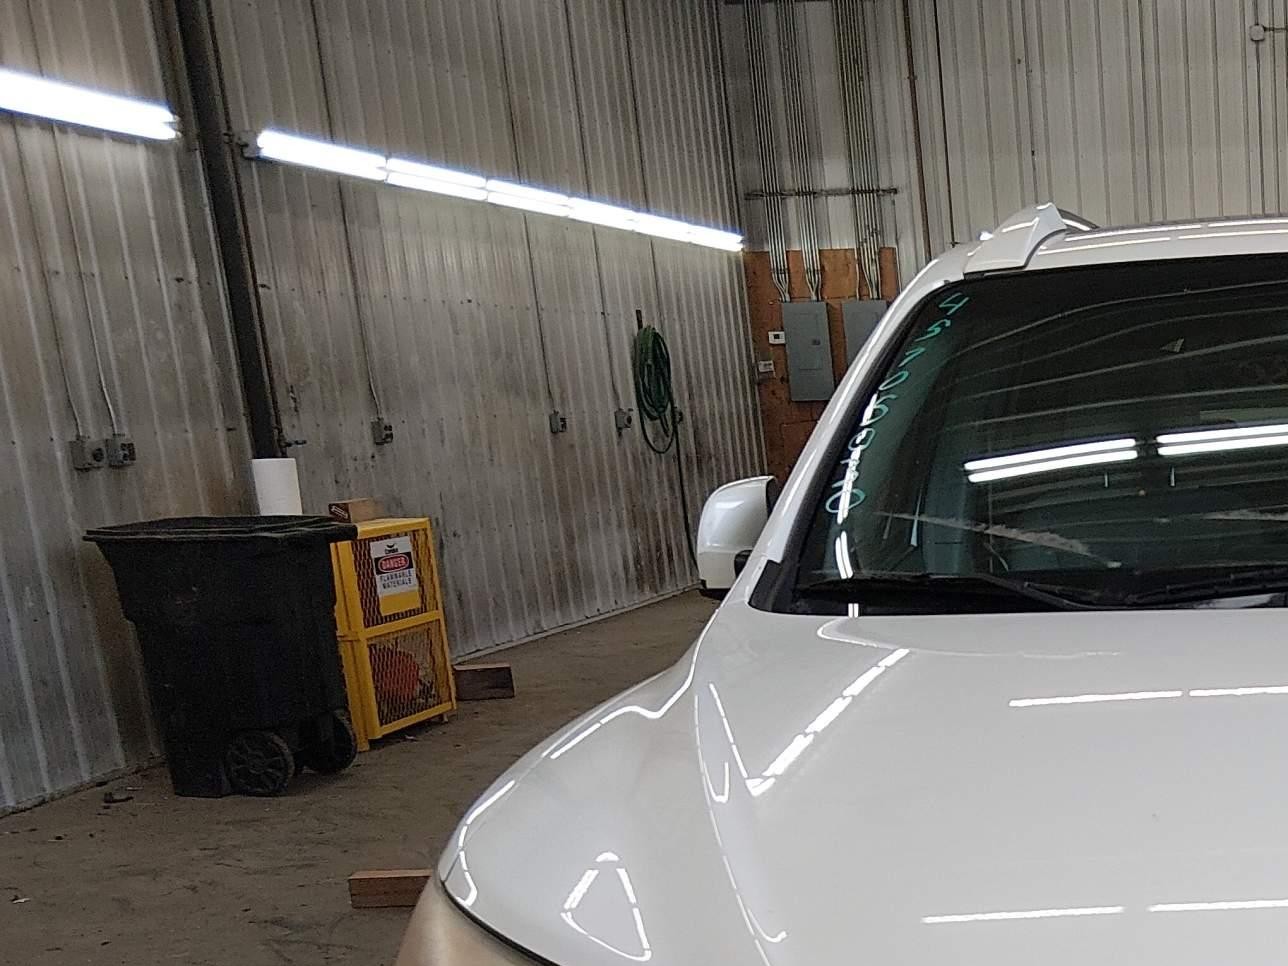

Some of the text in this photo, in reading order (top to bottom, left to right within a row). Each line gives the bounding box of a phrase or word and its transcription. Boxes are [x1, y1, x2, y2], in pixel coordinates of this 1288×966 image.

[381, 556, 408, 569] DANGER
[380, 569, 412, 582] FLAMMABLE
[382, 578, 412, 590] MATERIALS
